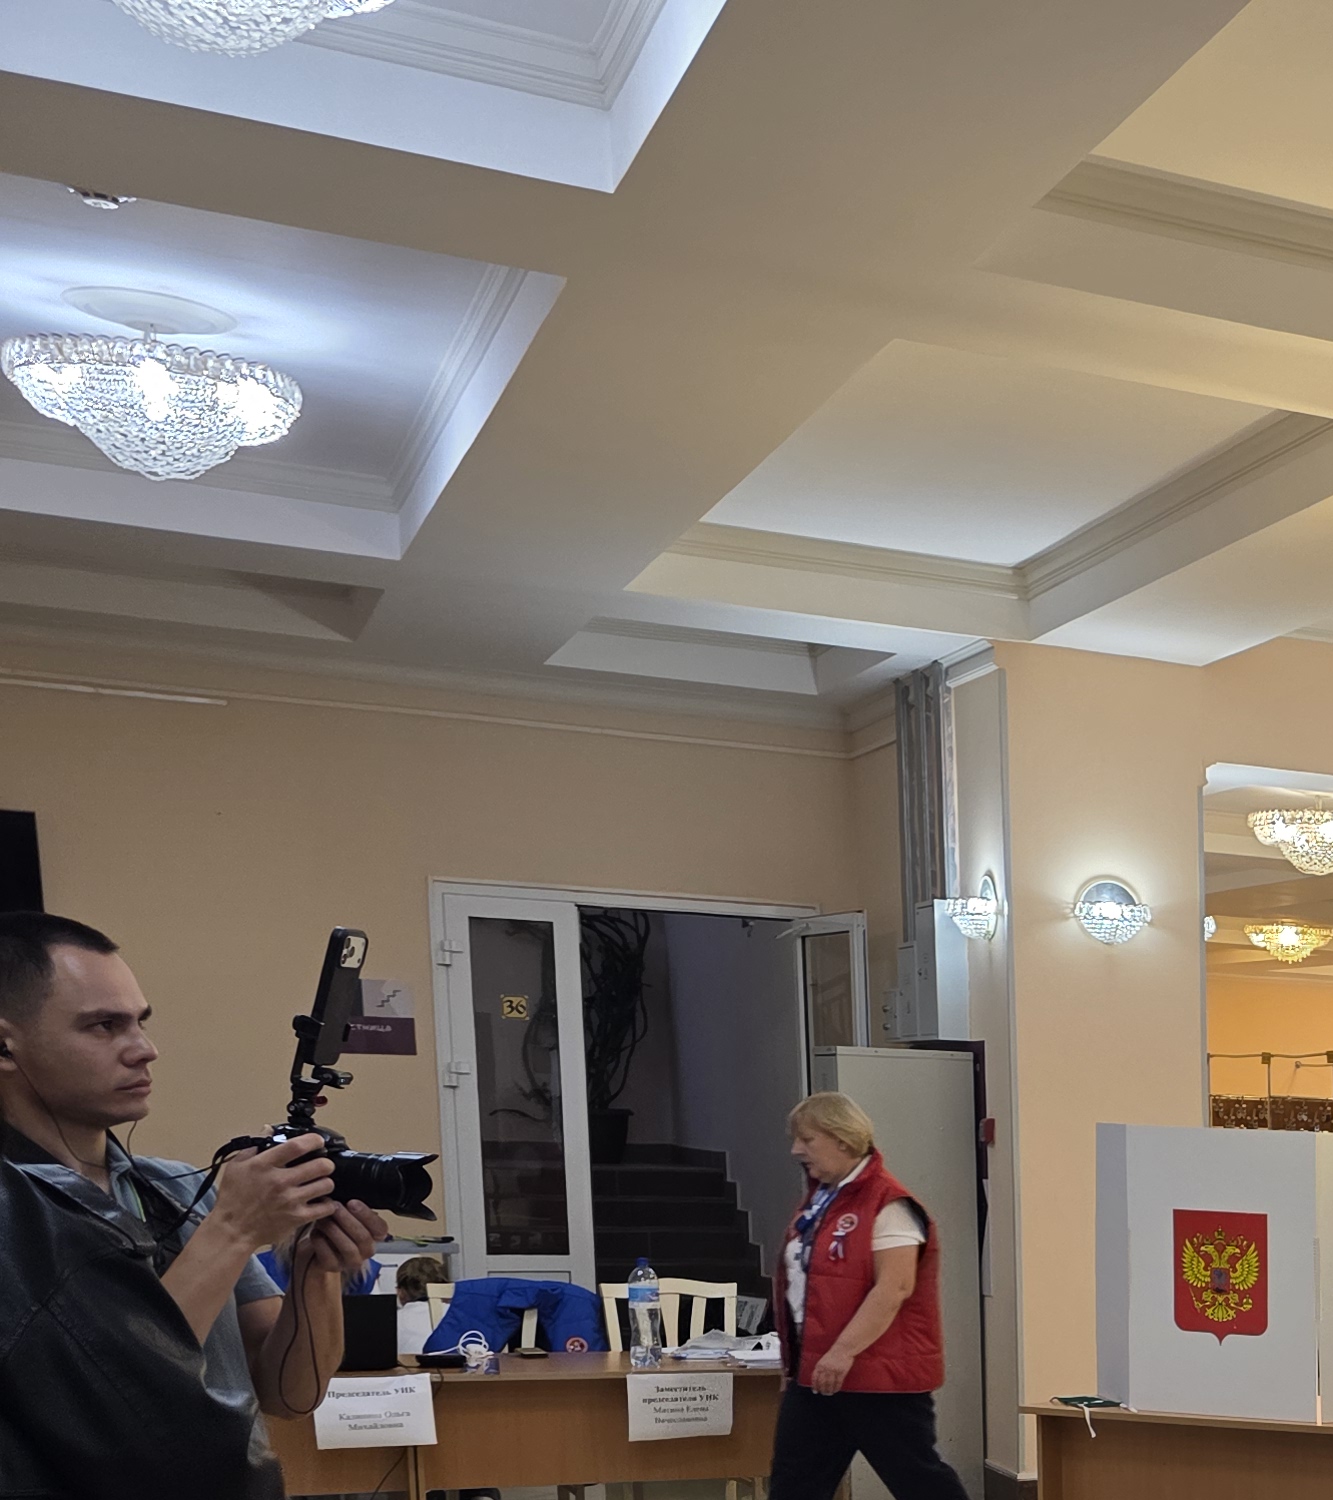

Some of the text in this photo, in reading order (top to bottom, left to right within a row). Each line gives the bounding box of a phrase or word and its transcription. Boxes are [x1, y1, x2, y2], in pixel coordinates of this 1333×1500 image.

[503, 999, 526, 1015] 36
[327, 1386, 416, 1399] Председатель УИК
[699, 1394, 719, 1402] УИК
